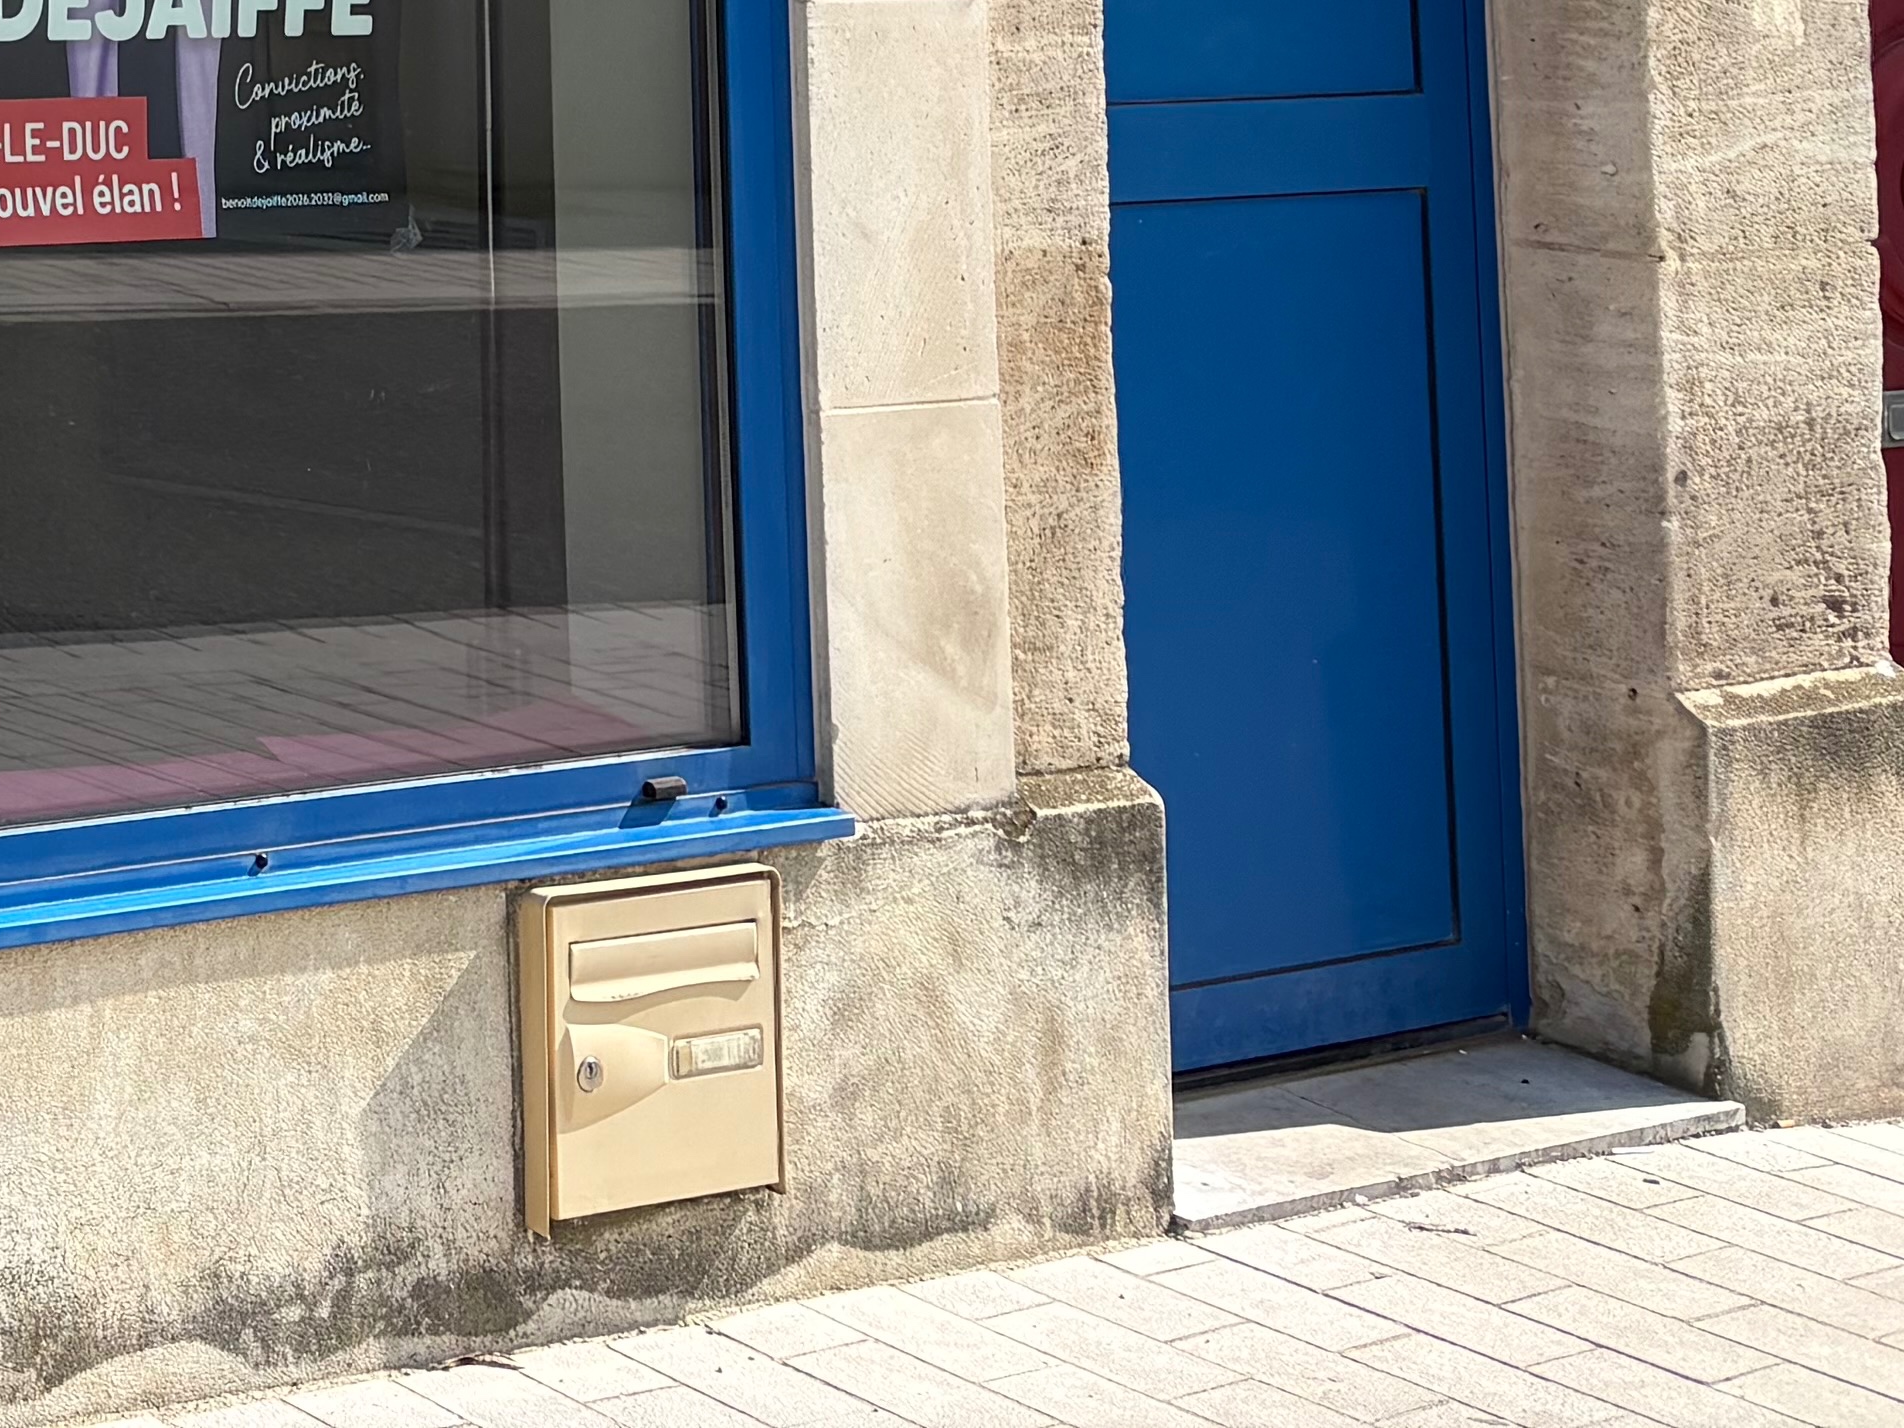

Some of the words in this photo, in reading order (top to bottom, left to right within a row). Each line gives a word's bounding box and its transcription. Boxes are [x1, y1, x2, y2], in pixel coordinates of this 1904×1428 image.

[270, 89, 364, 151] proximité
[253, 140, 271, 174] &
[92, 171, 162, 214] élan
[172, 171, 182, 211] !
